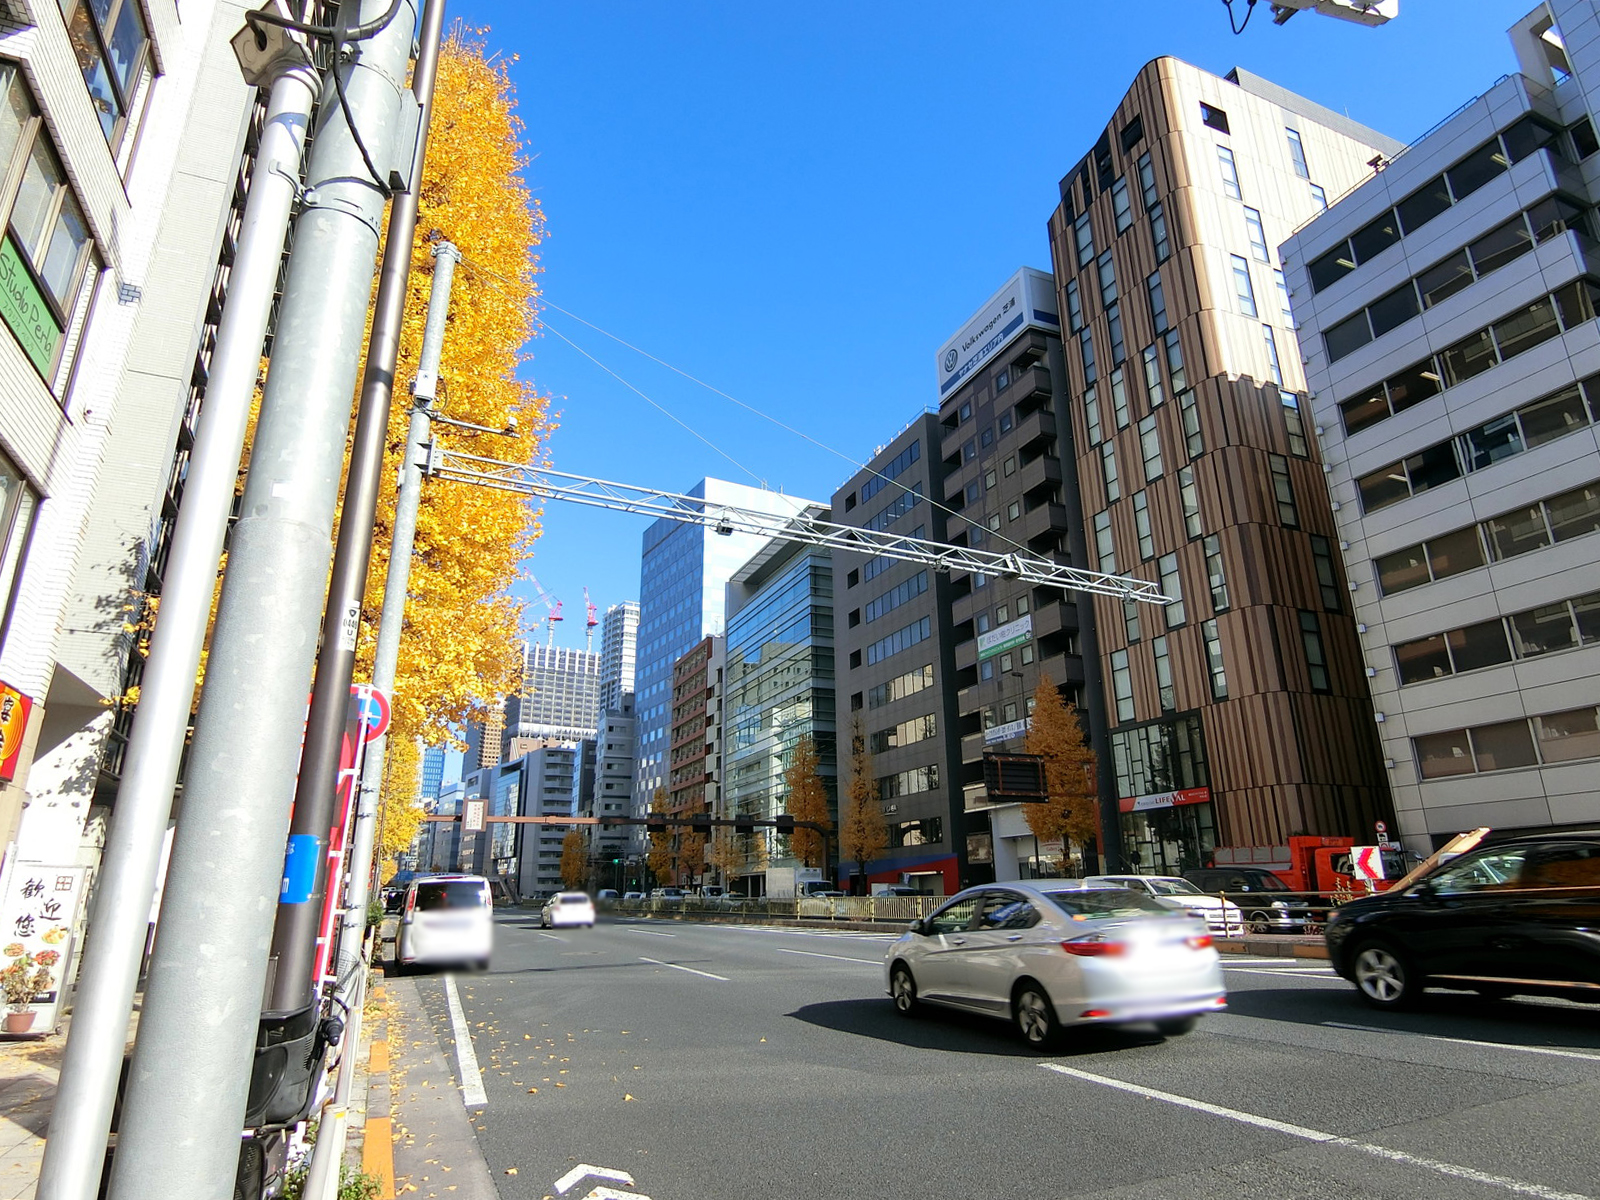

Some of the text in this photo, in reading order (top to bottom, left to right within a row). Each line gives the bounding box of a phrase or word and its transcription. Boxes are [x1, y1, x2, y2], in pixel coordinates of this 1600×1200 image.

[0, 253, 51, 358] Studio Perla
[962, 313, 1002, 352] Volkswagen
